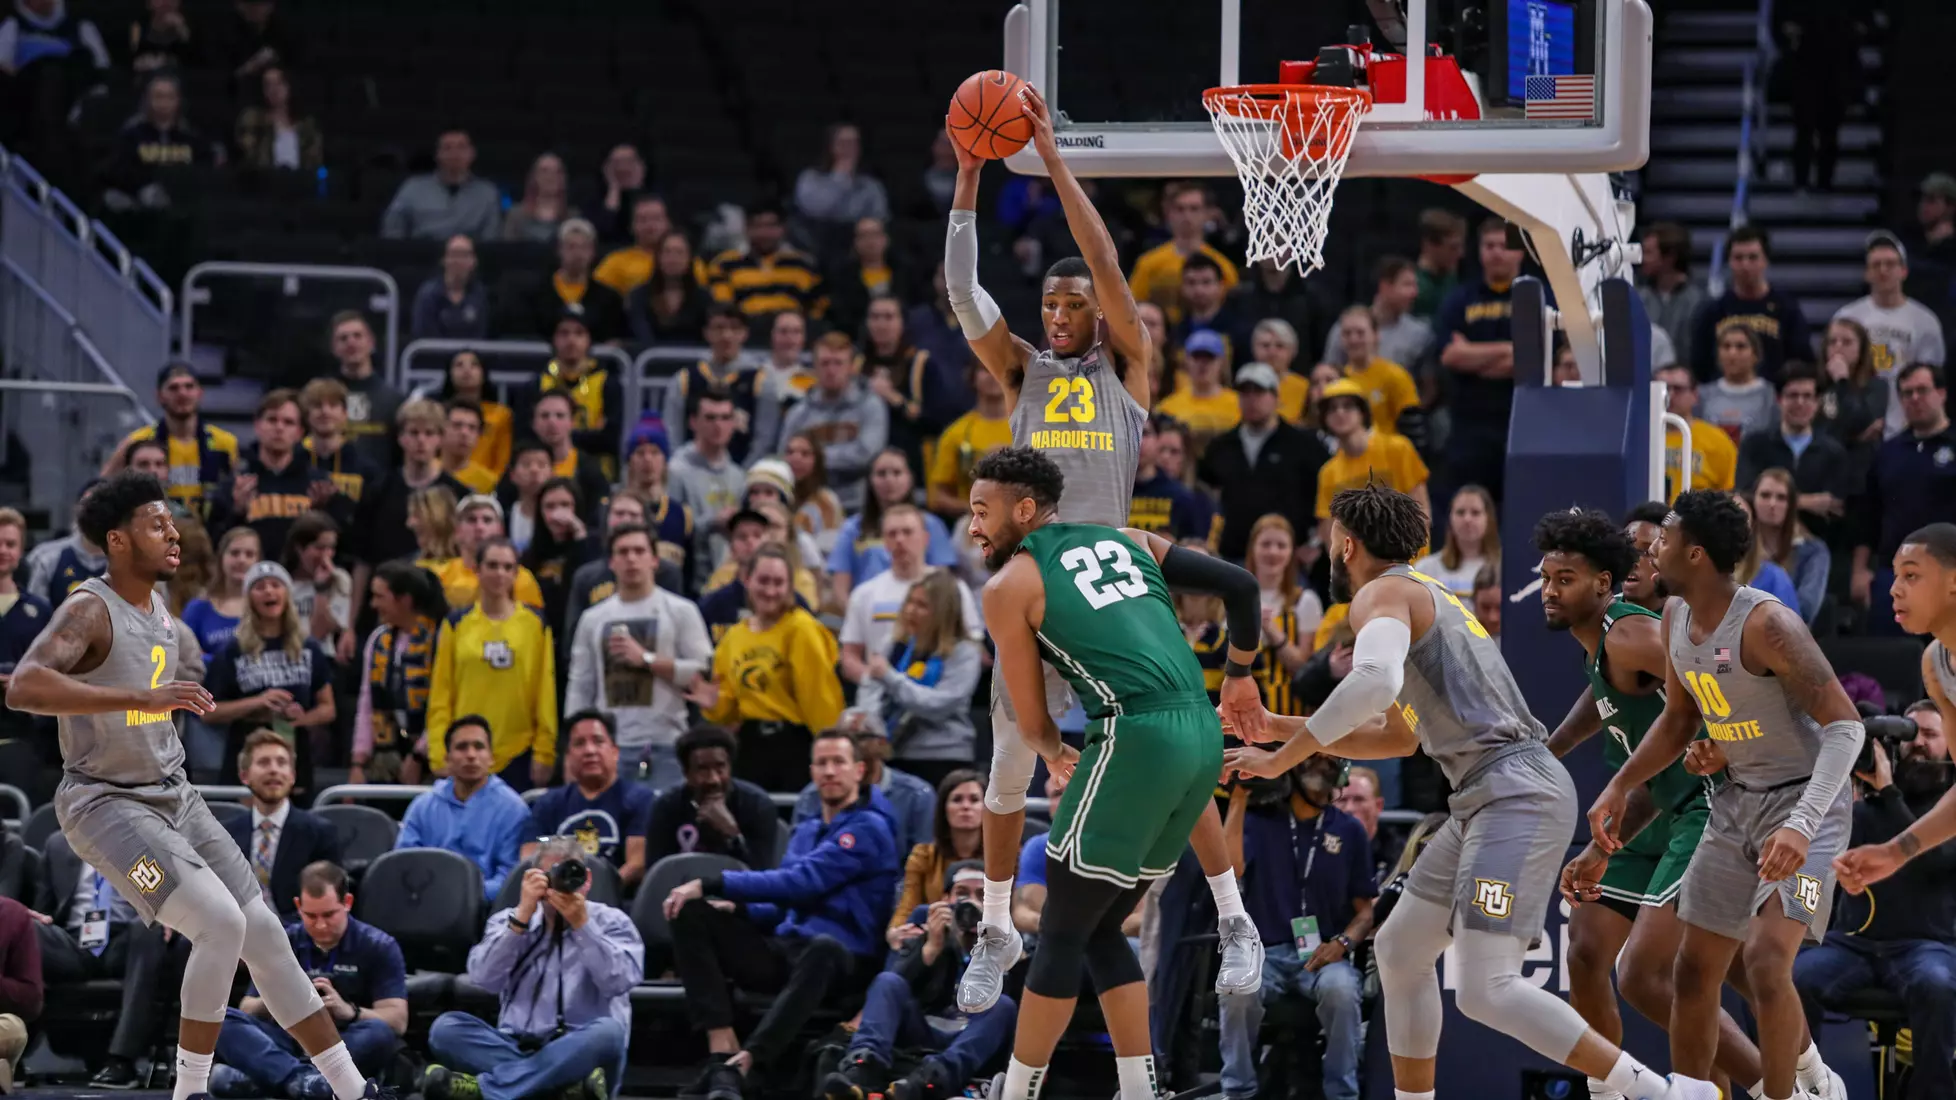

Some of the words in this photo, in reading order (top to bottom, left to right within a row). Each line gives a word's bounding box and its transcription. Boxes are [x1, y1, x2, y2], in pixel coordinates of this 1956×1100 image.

[1055, 134, 1105, 148] PALDING
[1044, 376, 1096, 423] 23
[1031, 429, 1114, 451] MARQUETTE
[1060, 540, 1148, 610] 23
[151, 645, 166, 690] 2
[1685, 670, 1731, 717] 10
[127, 855, 164, 893] MU
[1795, 873, 1822, 914] MU
[1472, 878, 1514, 918] MU
